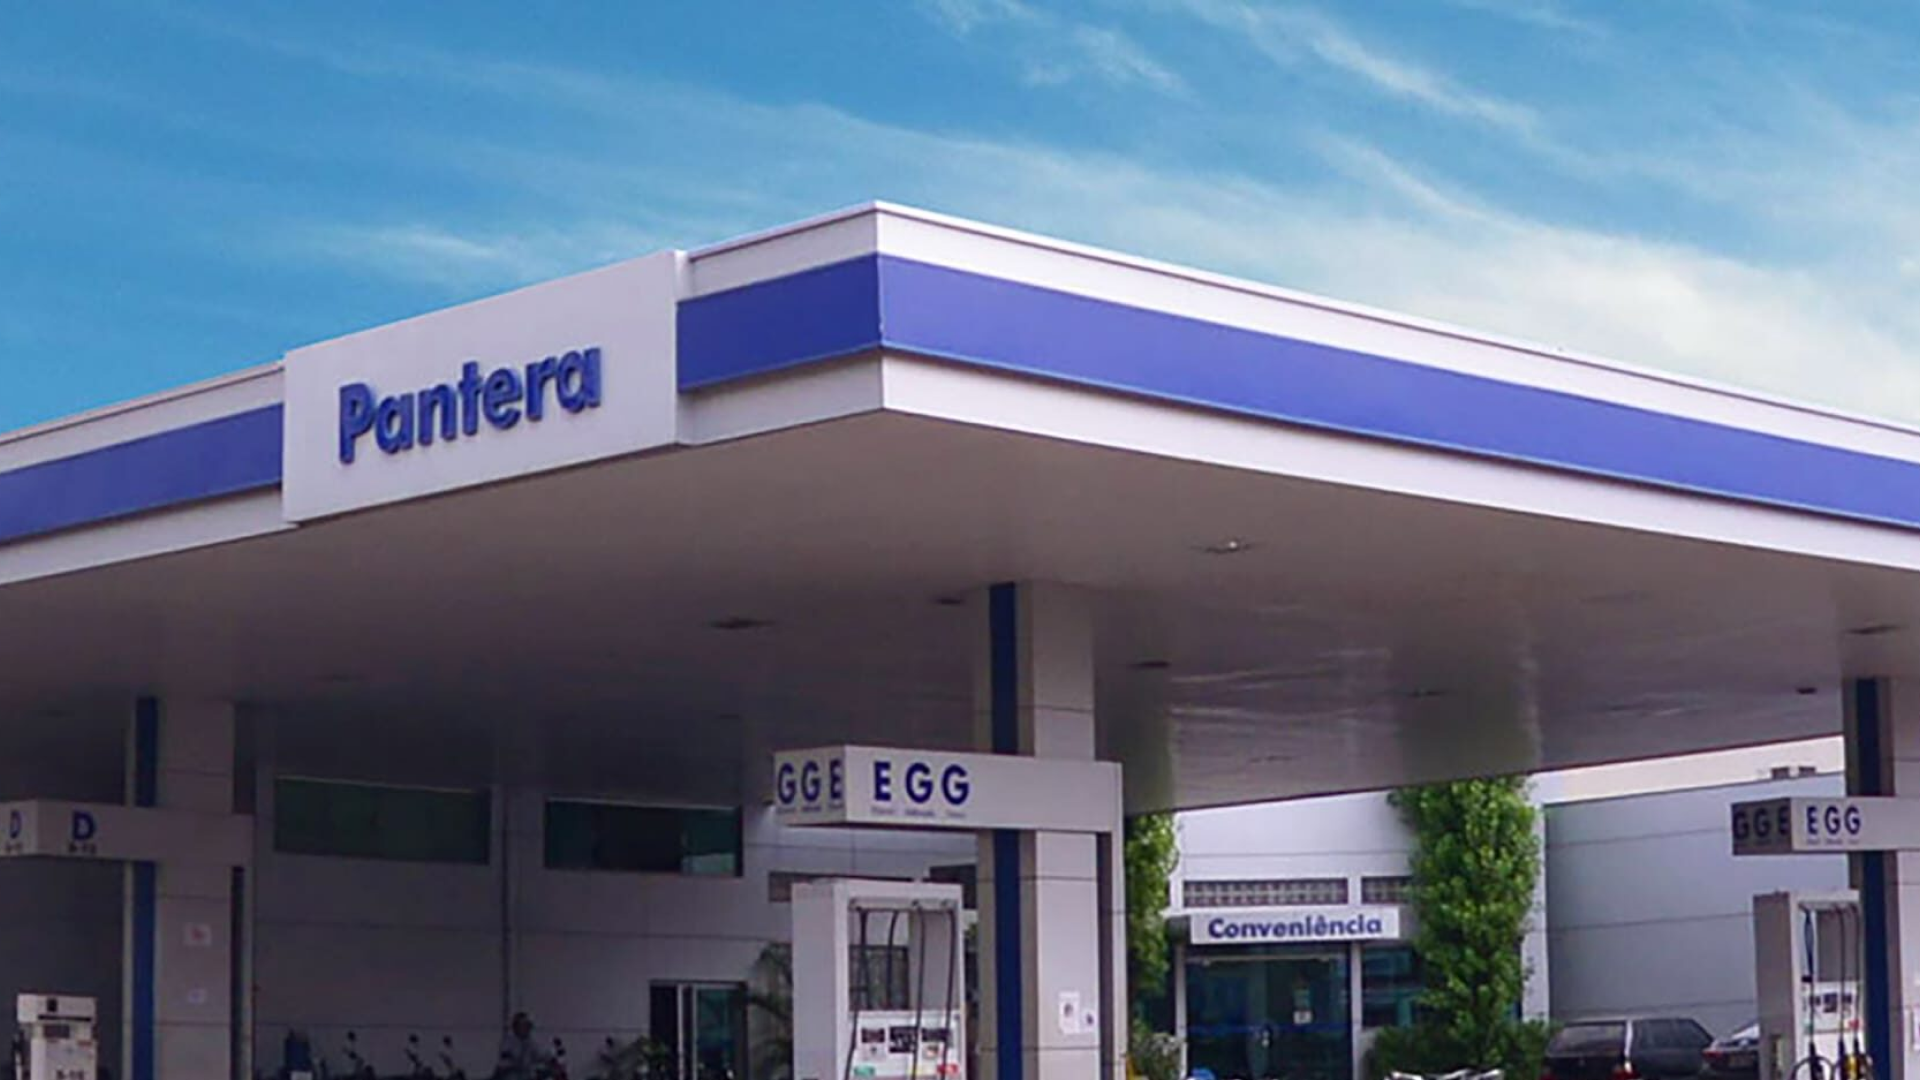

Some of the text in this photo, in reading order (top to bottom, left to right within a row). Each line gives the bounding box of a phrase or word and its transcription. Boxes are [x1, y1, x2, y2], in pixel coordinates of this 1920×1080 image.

[339, 346, 602, 465] Pantera
[72, 811, 96, 840] D
[1208, 914, 1382, 939] Conveniência
